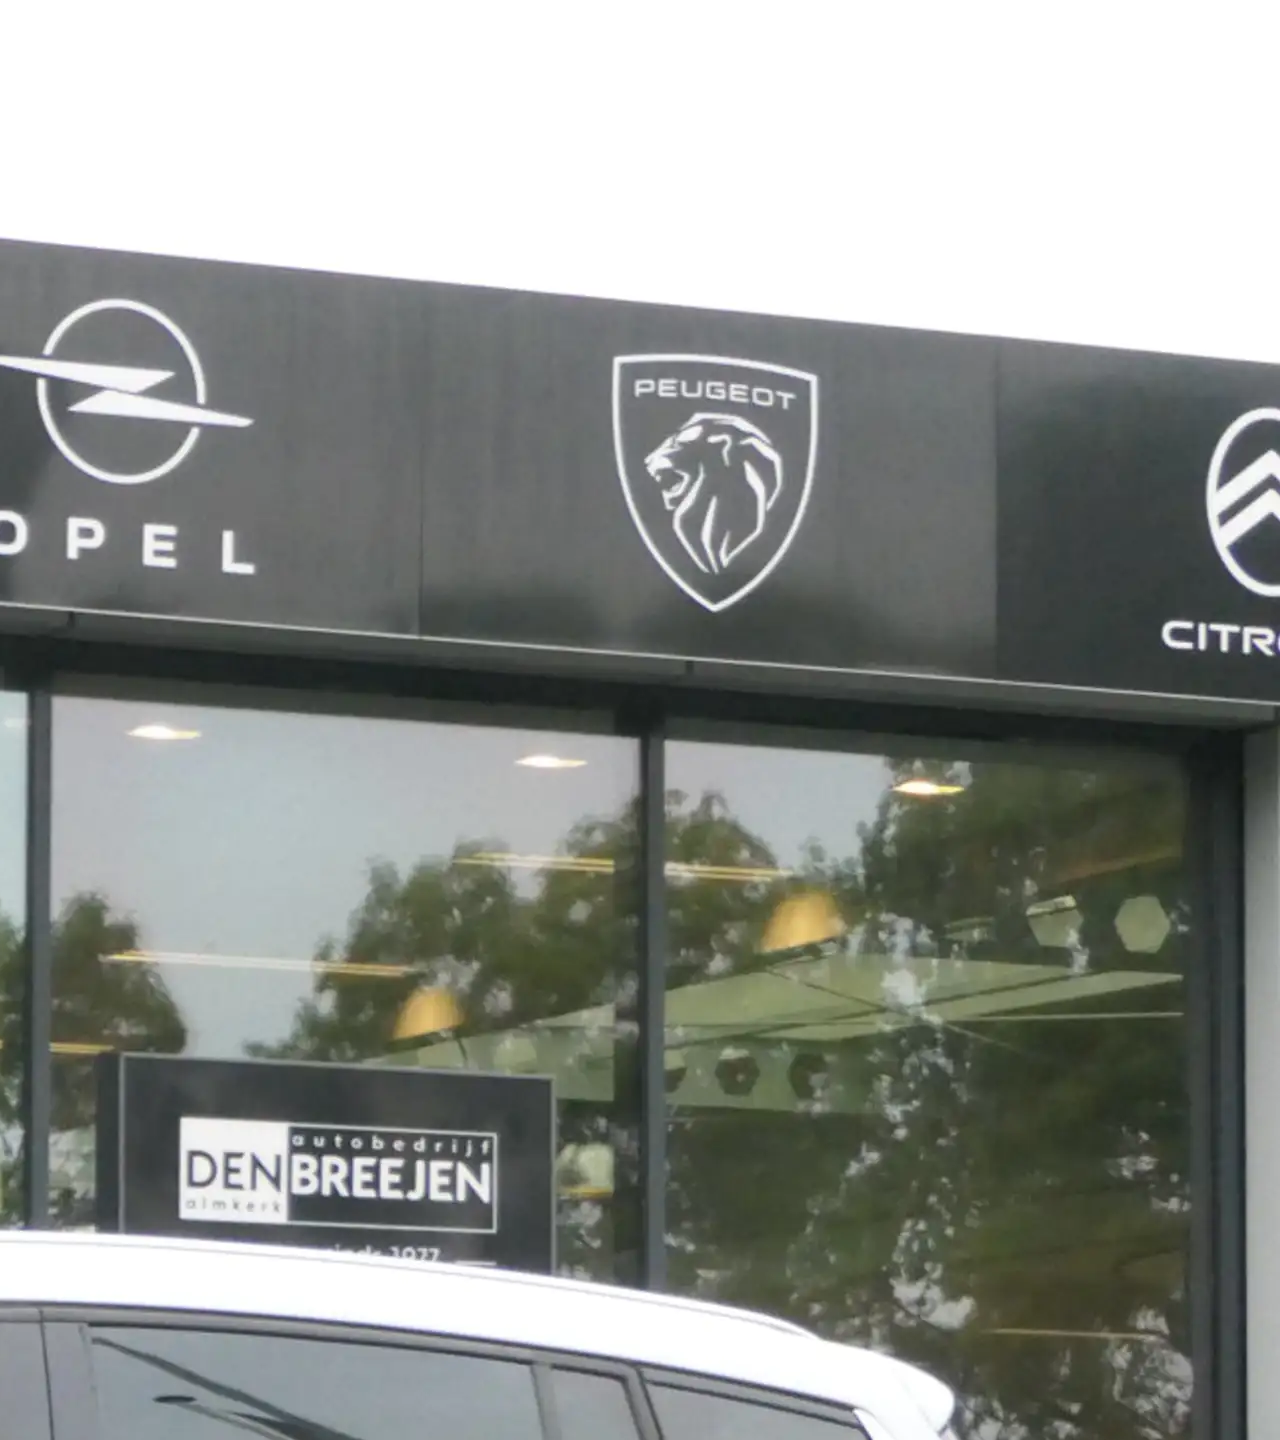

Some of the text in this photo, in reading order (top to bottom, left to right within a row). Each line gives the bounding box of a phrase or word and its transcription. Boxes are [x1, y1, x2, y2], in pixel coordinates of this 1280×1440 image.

[634, 378, 797, 410] PEUGEOT
[1161, 620, 1280, 656] CITR
[292, 1134, 490, 1158] autobedrijf
[186, 1149, 491, 1204] DEN BREEJEN
[186, 1198, 281, 1214] almkerk
